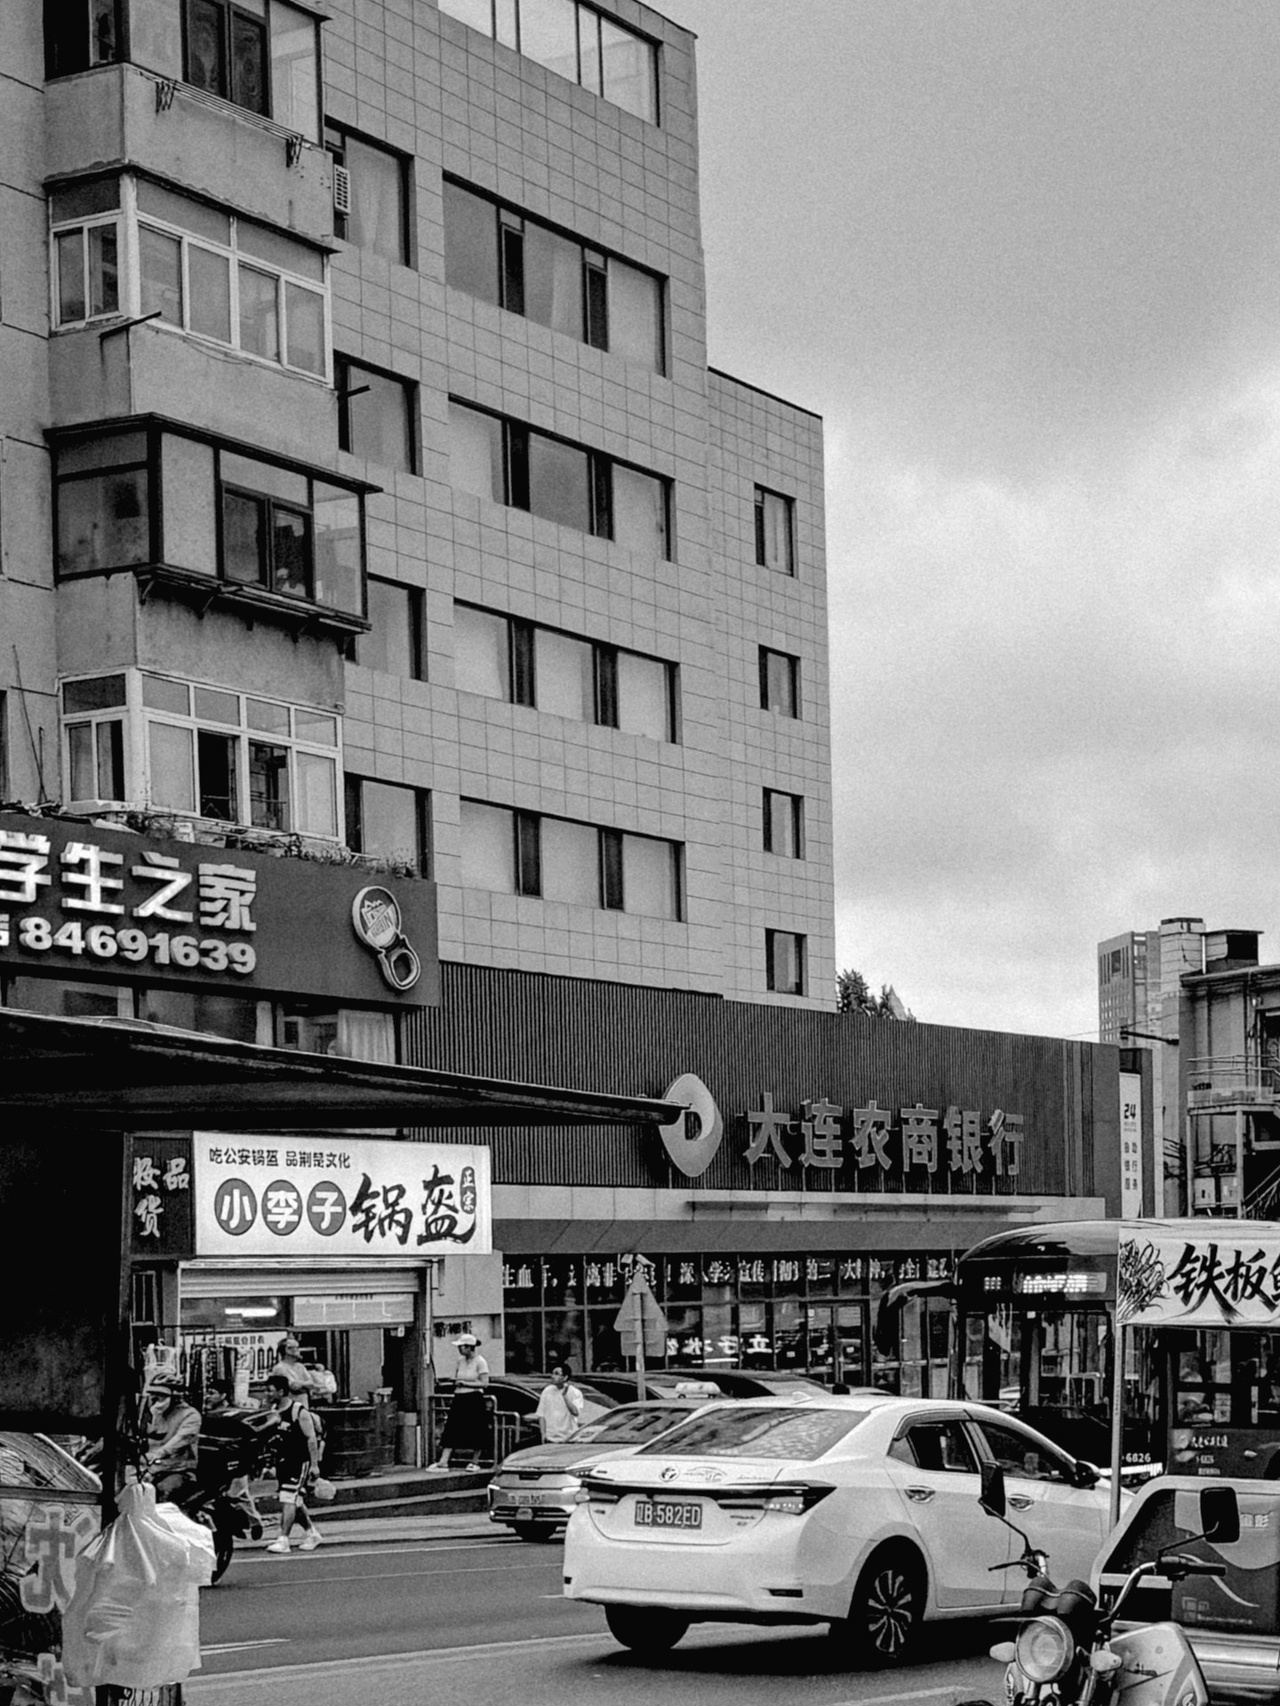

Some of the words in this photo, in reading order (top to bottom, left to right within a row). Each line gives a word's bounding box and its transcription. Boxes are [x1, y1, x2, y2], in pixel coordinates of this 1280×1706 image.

[19, 916, 257, 975] 84691639
[743, 1092, 1024, 1175] 大连农商银行
[350, 1164, 476, 1246] 锅盔
